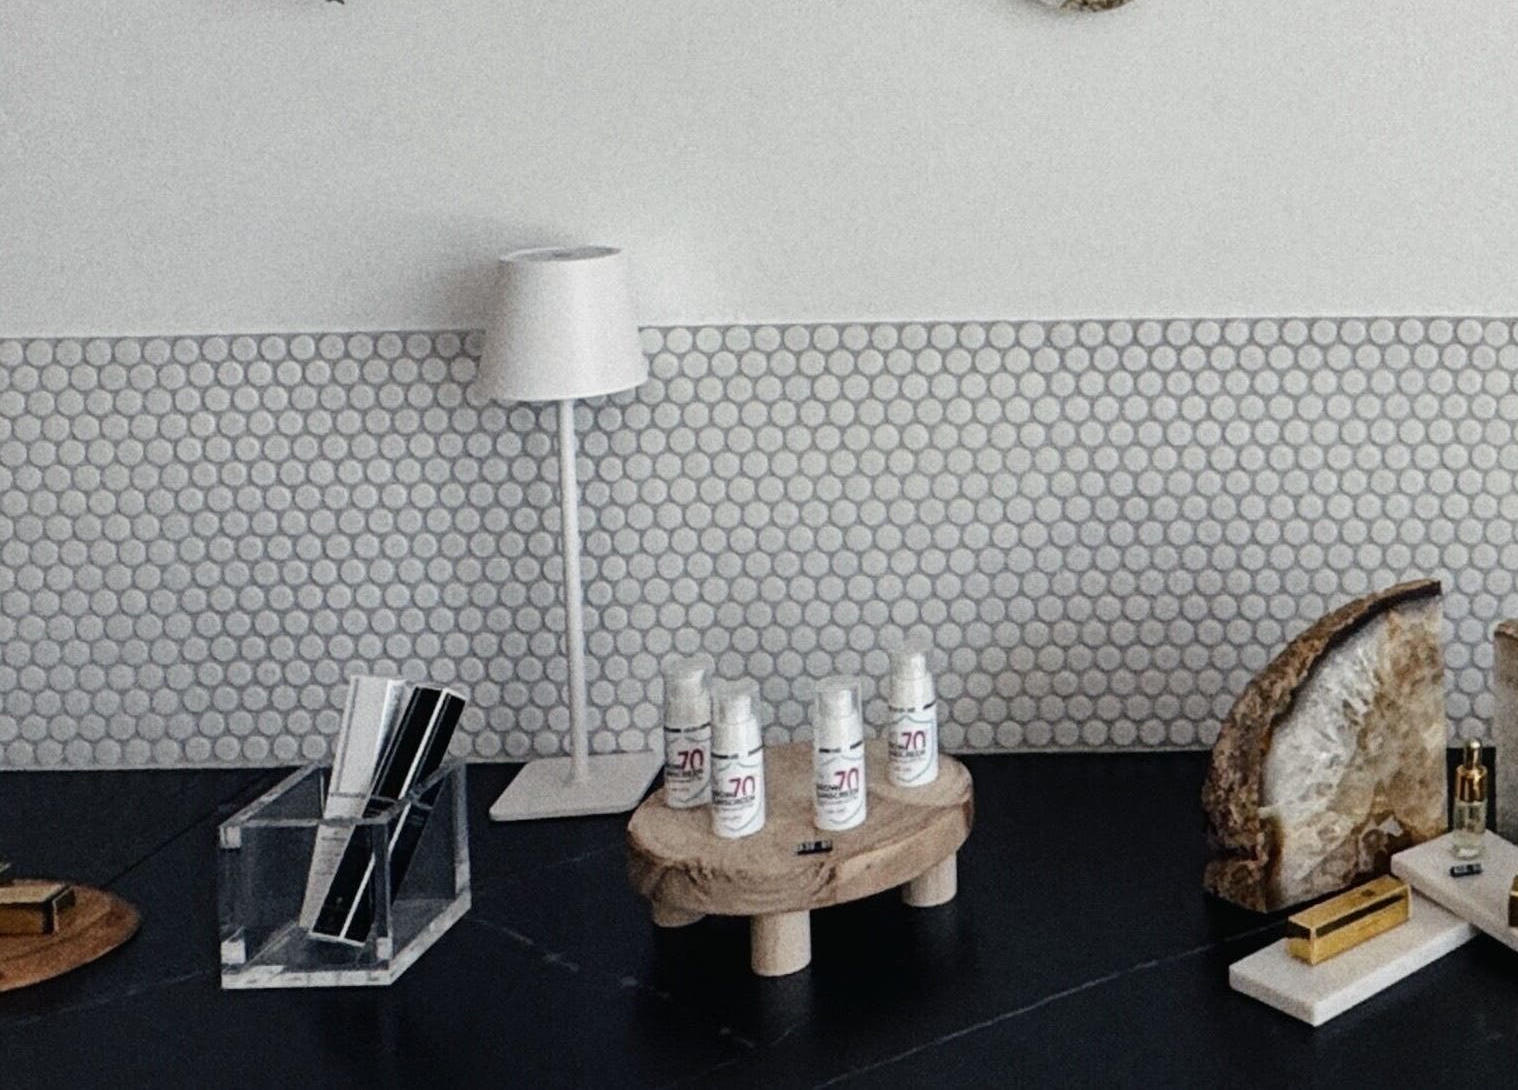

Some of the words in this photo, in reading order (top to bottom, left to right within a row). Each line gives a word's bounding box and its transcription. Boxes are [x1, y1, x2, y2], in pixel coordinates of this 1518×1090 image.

[901, 730, 926, 751] 70
[677, 748, 704, 770] 70
[728, 775, 756, 798] 70
[834, 767, 860, 791] 70
